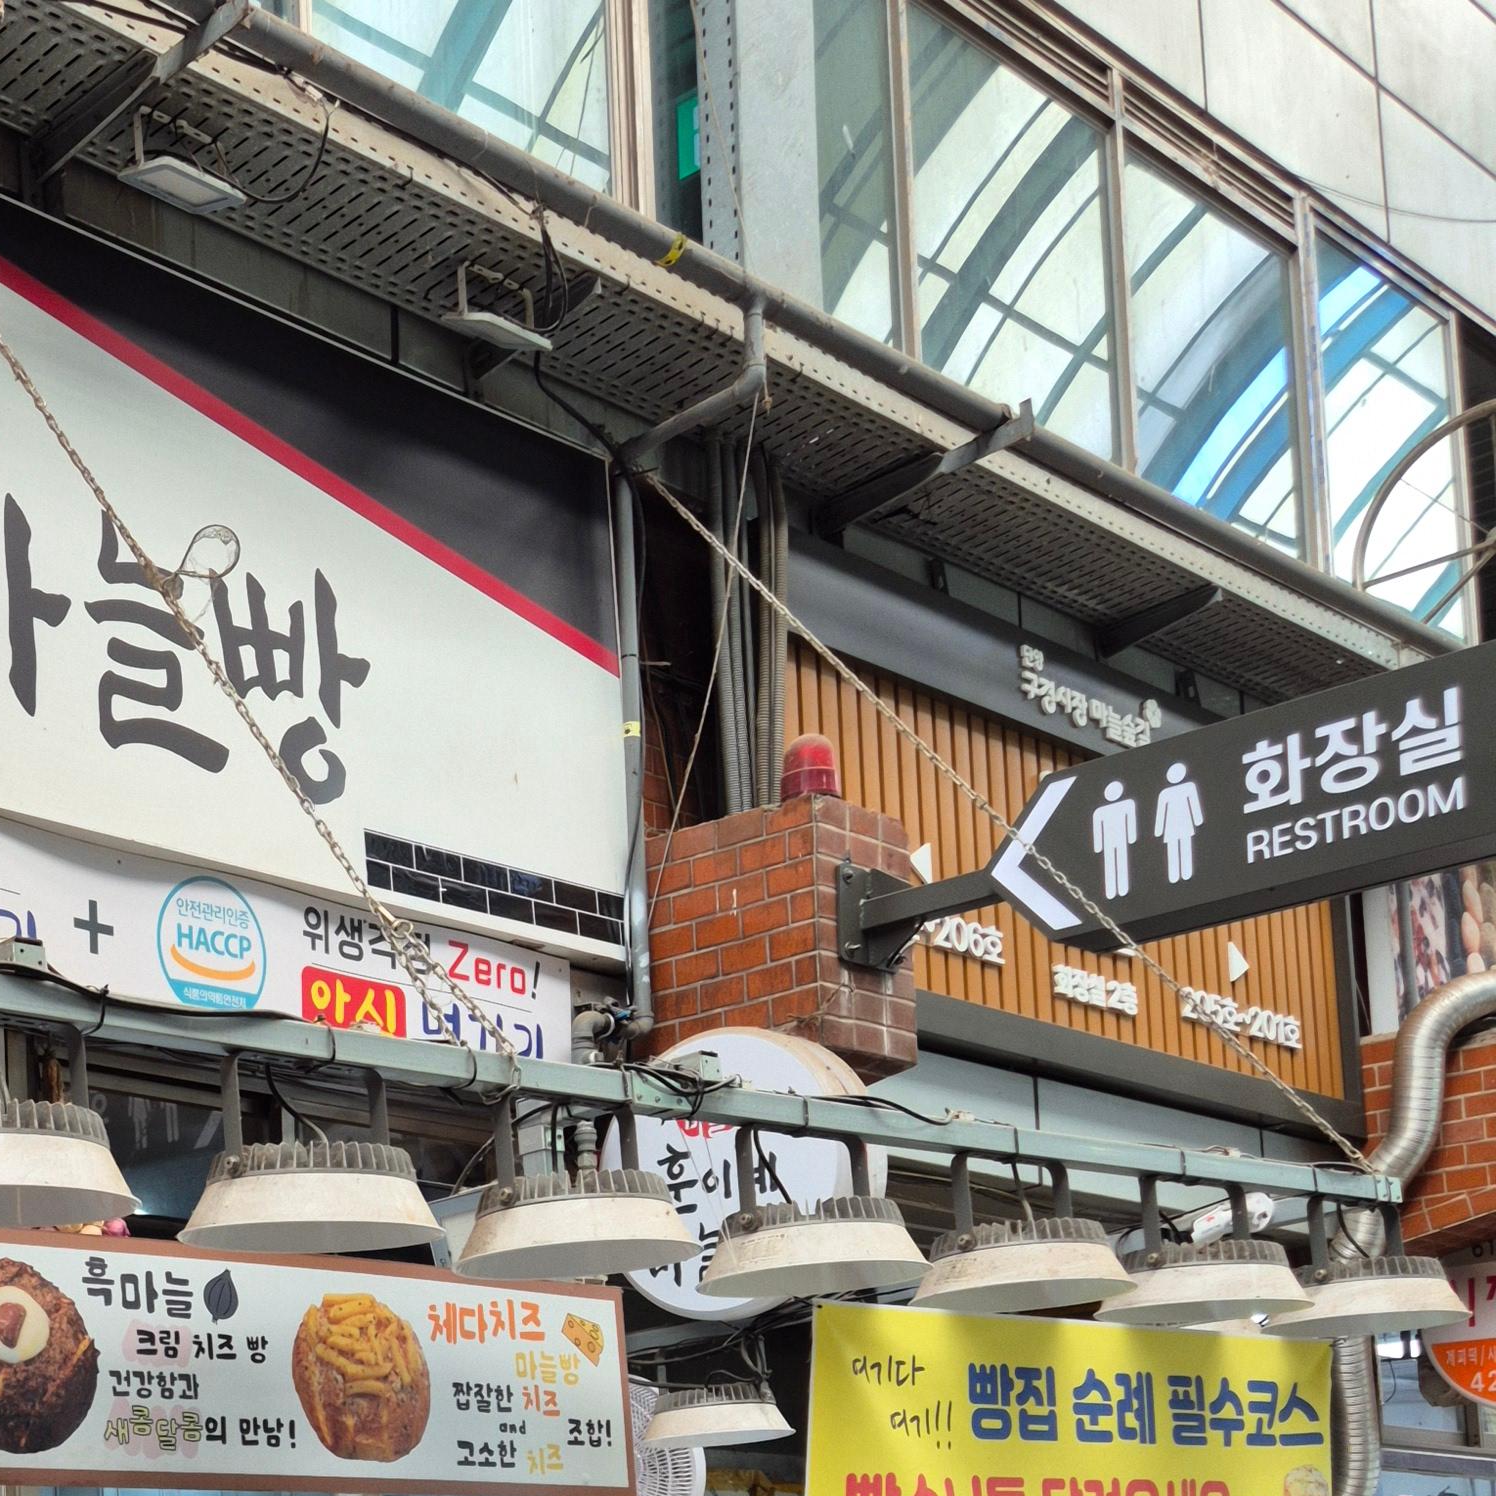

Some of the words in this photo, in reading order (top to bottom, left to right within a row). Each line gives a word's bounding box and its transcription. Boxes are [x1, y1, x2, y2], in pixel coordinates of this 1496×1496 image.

[1020, 670, 1089, 728] 구경시장
[1241, 686, 1463, 815] 화장실
[1246, 775, 1466, 864] RESTROOM
[176, 897, 250, 930] 안전관리인증
[176, 922, 253, 960] HACCP
[448, 939, 541, 1000] Zero!
[1052, 963, 1105, 1009] 화장실
[82, 1256, 194, 1320] 흑마늘
[427, 1298, 546, 1345] 체다치즈
[108, 1369, 200, 1401] 건강함과
[515, 1351, 581, 1387] 마늘빵
[851, 1355, 926, 1388] 여기다
[521, 1384, 562, 1418] 치즈
[967, 1362, 1060, 1443] 빵집
[1071, 1367, 1158, 1446] 순례
[1165, 1374, 1325, 1448] 필수코스
[239, 1416, 297, 1449] 만남!
[498, 1419, 527, 1436] and
[567, 1418, 613, 1449] 조합!
[889, 1399, 954, 1451] 여기!!
[457, 1439, 518, 1470] 고소한
[527, 1443, 565, 1476] 치즈
